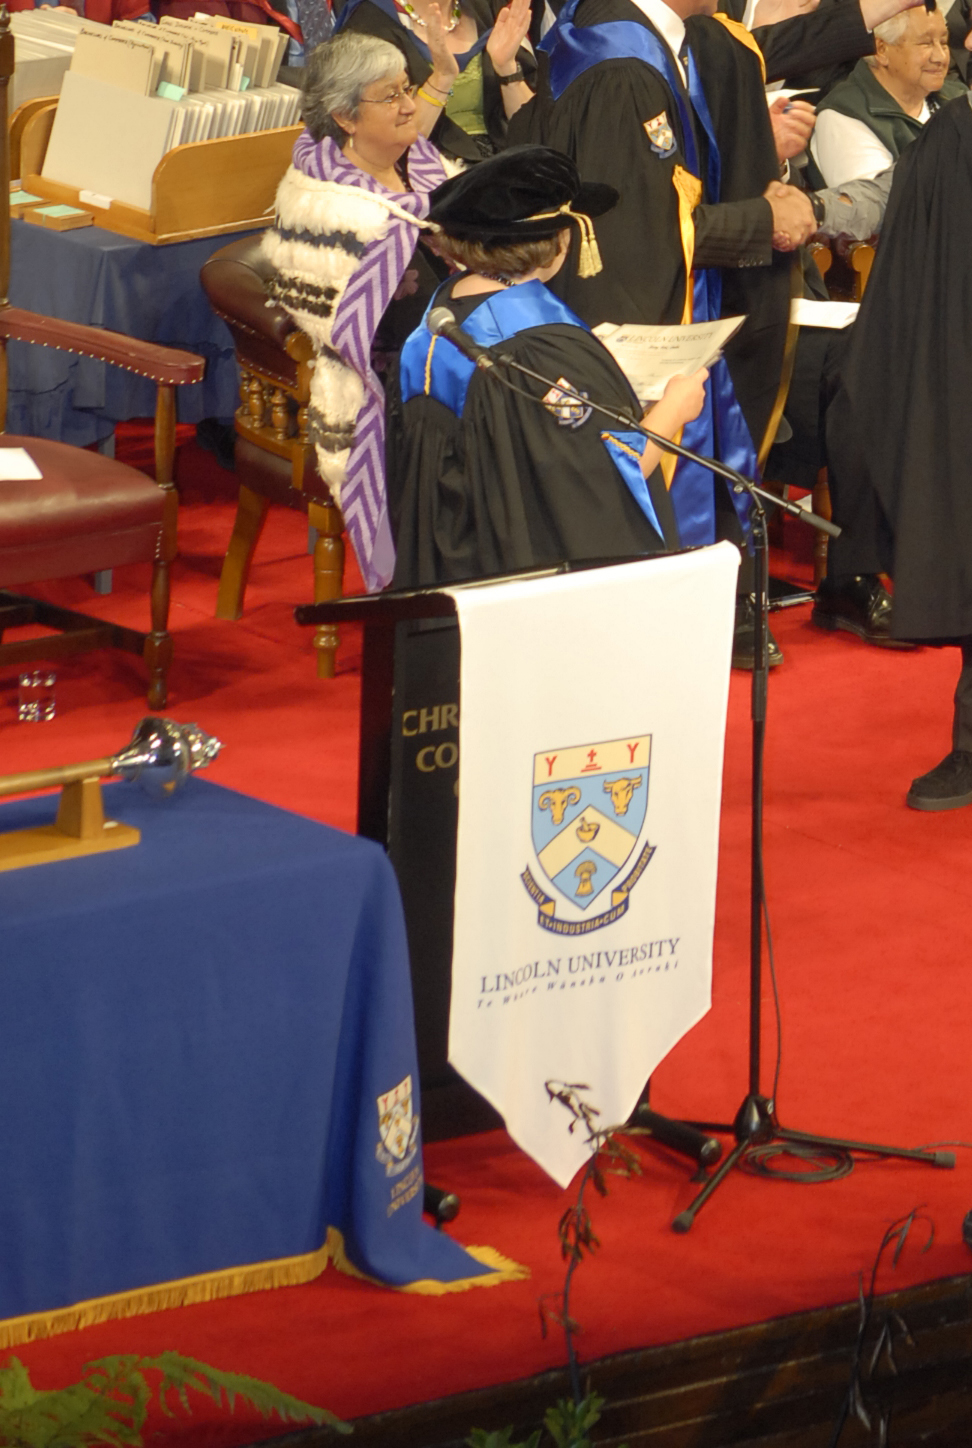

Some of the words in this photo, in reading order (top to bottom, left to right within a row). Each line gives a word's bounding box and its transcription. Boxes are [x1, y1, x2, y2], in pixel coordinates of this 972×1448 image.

[416, 742, 459, 772] CO
[480, 958, 561, 994] LINCOLN
[568, 938, 680, 974] UNIVERSITY
